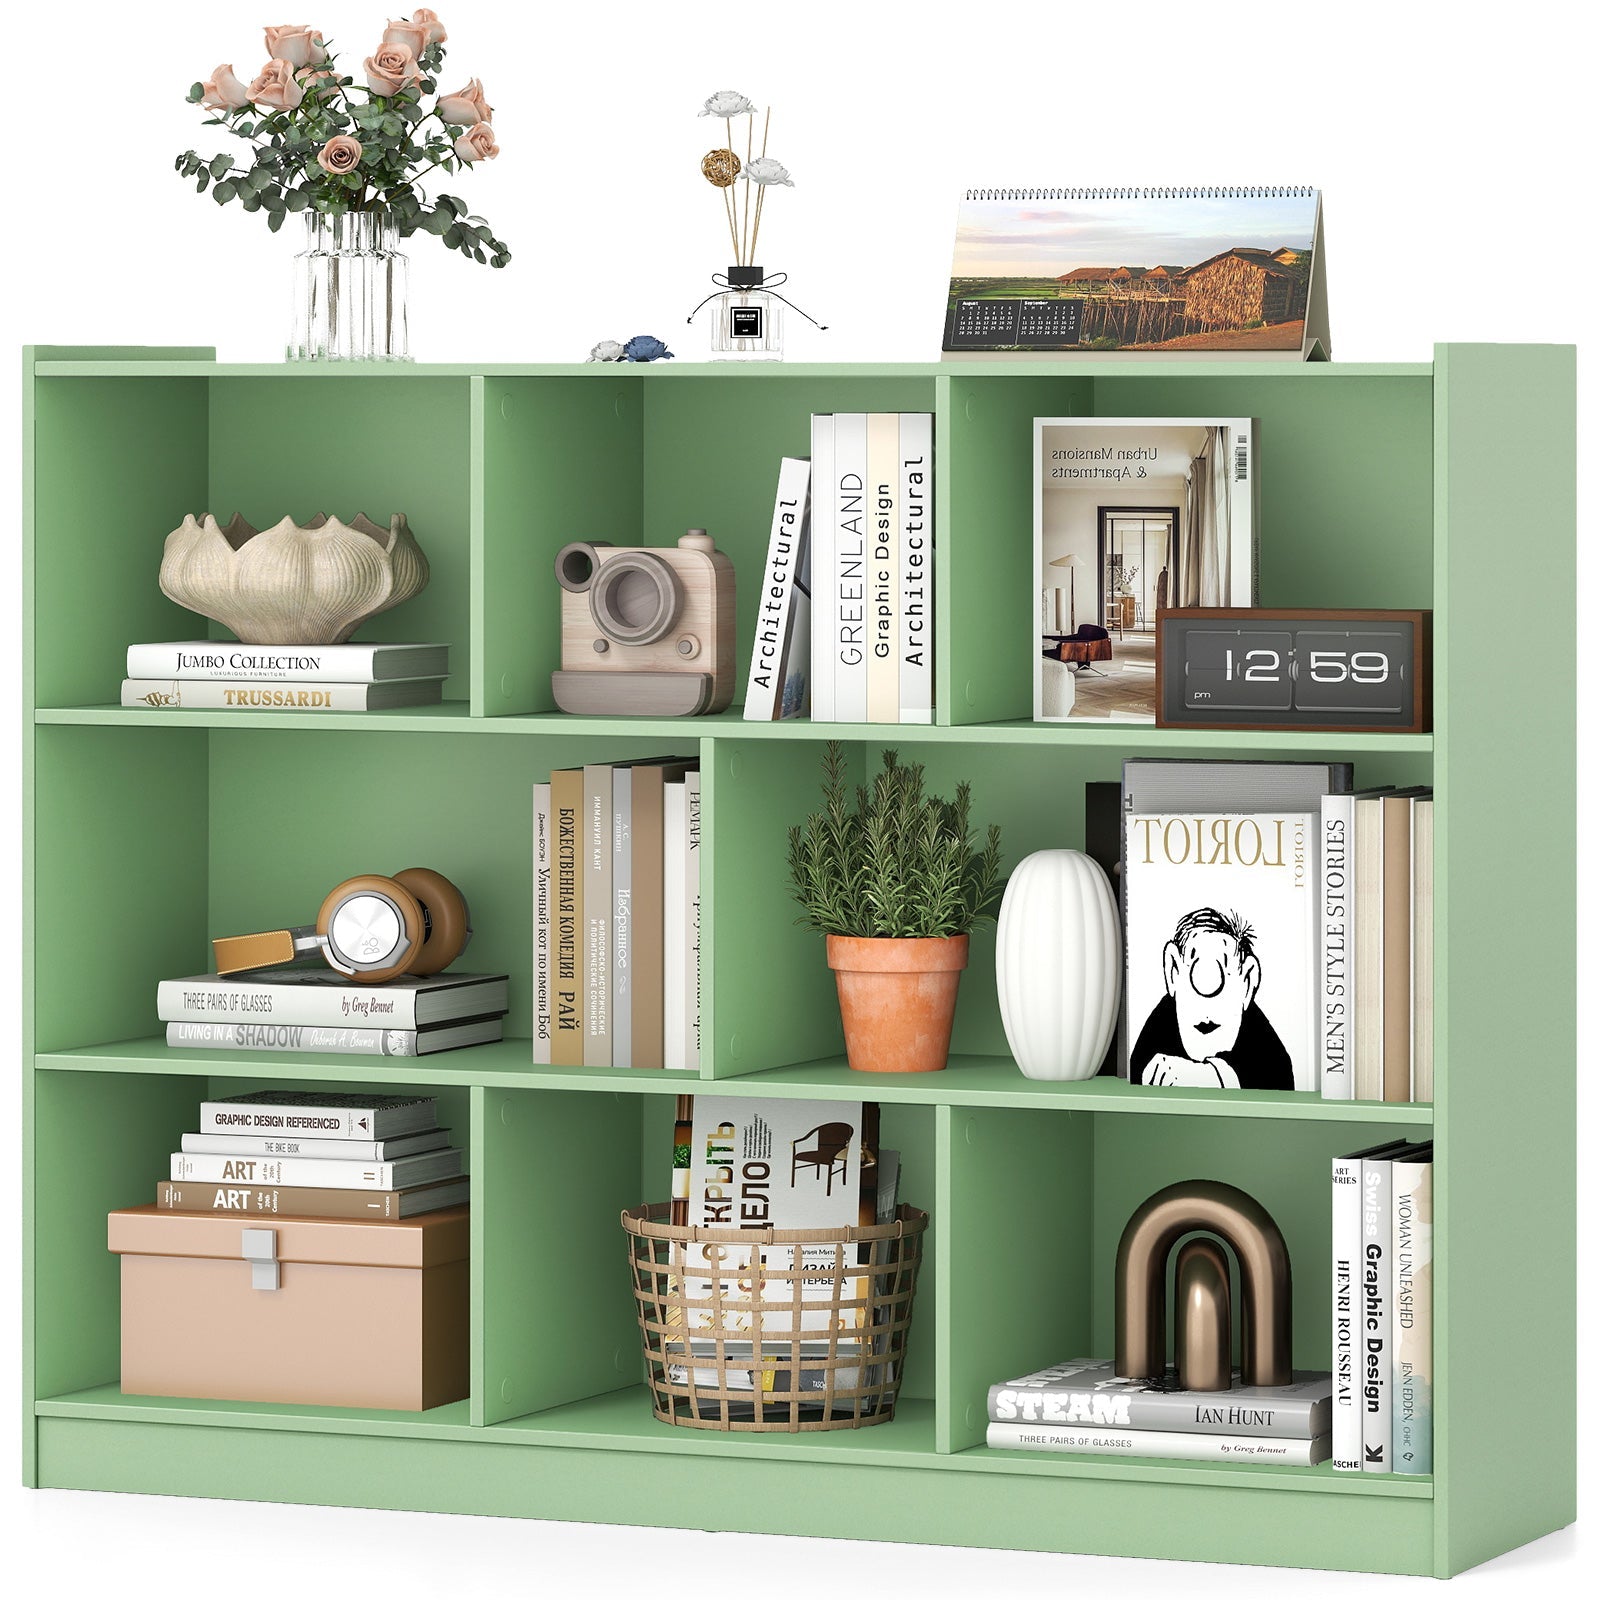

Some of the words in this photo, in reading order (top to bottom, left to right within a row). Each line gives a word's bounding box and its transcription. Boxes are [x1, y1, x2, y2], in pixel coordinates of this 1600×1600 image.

[875, 484, 892, 560] Design
[840, 473, 863, 665] GREENLAND
[904, 456, 923, 666] Architectural
[754, 499, 798, 688] Architectural
[875, 570, 892, 658] Graphic
[176, 652, 225, 673] JUMBO
[230, 652, 320, 670] COLLECTION
[1310, 651, 1389, 684] 59
[223, 689, 331, 708] TRUSSARDI
[1194, 692, 1211, 700] pm
[593, 796, 601, 845] ИММАНУИЛ
[559, 808, 574, 912] БОЖЕСТВЕННАЯ
[593, 848, 602, 871] КАНТ
[1326, 819, 1345, 918] STORIES
[538, 868, 550, 924] Уличный
[538, 928, 546, 950] кот
[614, 888, 631, 968] Избранное
[538, 953, 546, 969] по
[558, 916, 574, 978] КОМЕДИЯ
[590, 928, 598, 988] ПОЛИТИЧЕСКИЕ
[1326, 924, 1345, 996] STYLE
[183, 992, 205, 1010] THREE
[207, 993, 227, 1011] PAIRS
[229, 994, 239, 1012] OF
[240, 994, 273, 1012] GLASSES
[342, 996, 350, 1016] by
[352, 996, 369, 1018] Greg
[370, 998, 394, 1014] Bennet
[538, 971, 546, 1012] имени
[538, 1015, 550, 1039] Боб
[558, 991, 580, 1030] РАЙ
[590, 990, 598, 1036] СОЧИНЕНИЯ
[178, 1024, 212, 1041] LIVING
[214, 1026, 223, 1042] IN
[224, 1026, 233, 1042] A
[236, 1025, 303, 1048] SHADOW
[215, 1114, 252, 1127] GRAPHIC
[254, 1116, 284, 1128] DESIGN
[286, 1116, 340, 1130] REFERENCED
[264, 1142, 274, 1152] THE
[276, 1142, 286, 1153] BIKE
[287, 1143, 300, 1154] BOOK
[222, 1160, 256, 1180] ART
[1334, 1168, 1350, 1176] ART
[213, 1190, 251, 1210] ART
[1366, 1172, 1381, 1236] Swiss
[1398, 1194, 1412, 1248] WOMAN
[1338, 1260, 1350, 1312] HENRI
[1364, 1244, 1382, 1330] Graphic
[1400, 1254, 1414, 1329] UNLEASHED
[1338, 1318, 1351, 1406] ROUSSEAU
[1364, 1338, 1384, 1413] Design
[1400, 1362, 1412, 1386] JENN
[996, 1390, 1132, 1424] STEAM
[1194, 1404, 1224, 1425] IAN
[1228, 1406, 1274, 1426] HUNT
[1402, 1388, 1414, 1423] EDDEN,
[1019, 1434, 1047, 1444] THREE
[1050, 1436, 1075, 1445] PAIRS
[1078, 1437, 1090, 1446] OF
[1092, 1438, 1132, 1448] GLASSES
[1220, 1444, 1232, 1453] by
[1234, 1444, 1254, 1454] Greg
[1256, 1446, 1286, 1454] Bennet
[1334, 1460, 1362, 1468] ASCHE
